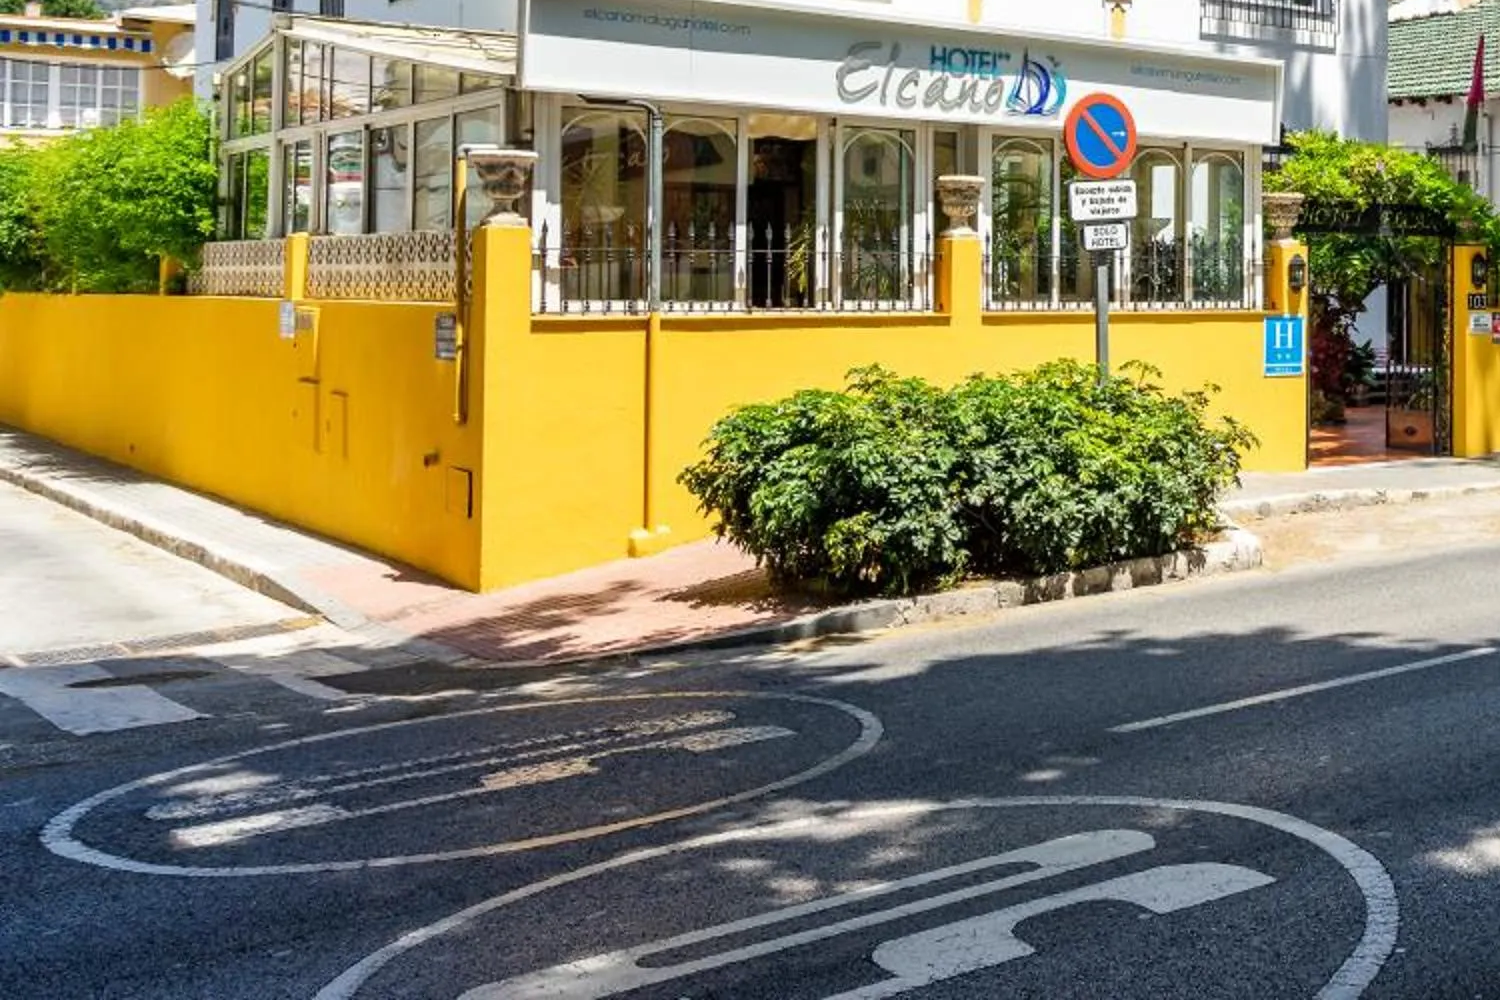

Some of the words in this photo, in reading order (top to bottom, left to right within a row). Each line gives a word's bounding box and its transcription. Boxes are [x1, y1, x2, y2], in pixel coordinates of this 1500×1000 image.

[836, 40, 1004, 115] Elcano
[931, 44, 999, 80] HOTEL
[1469, 295, 1487, 309] 103
[1273, 321, 1297, 349] H
